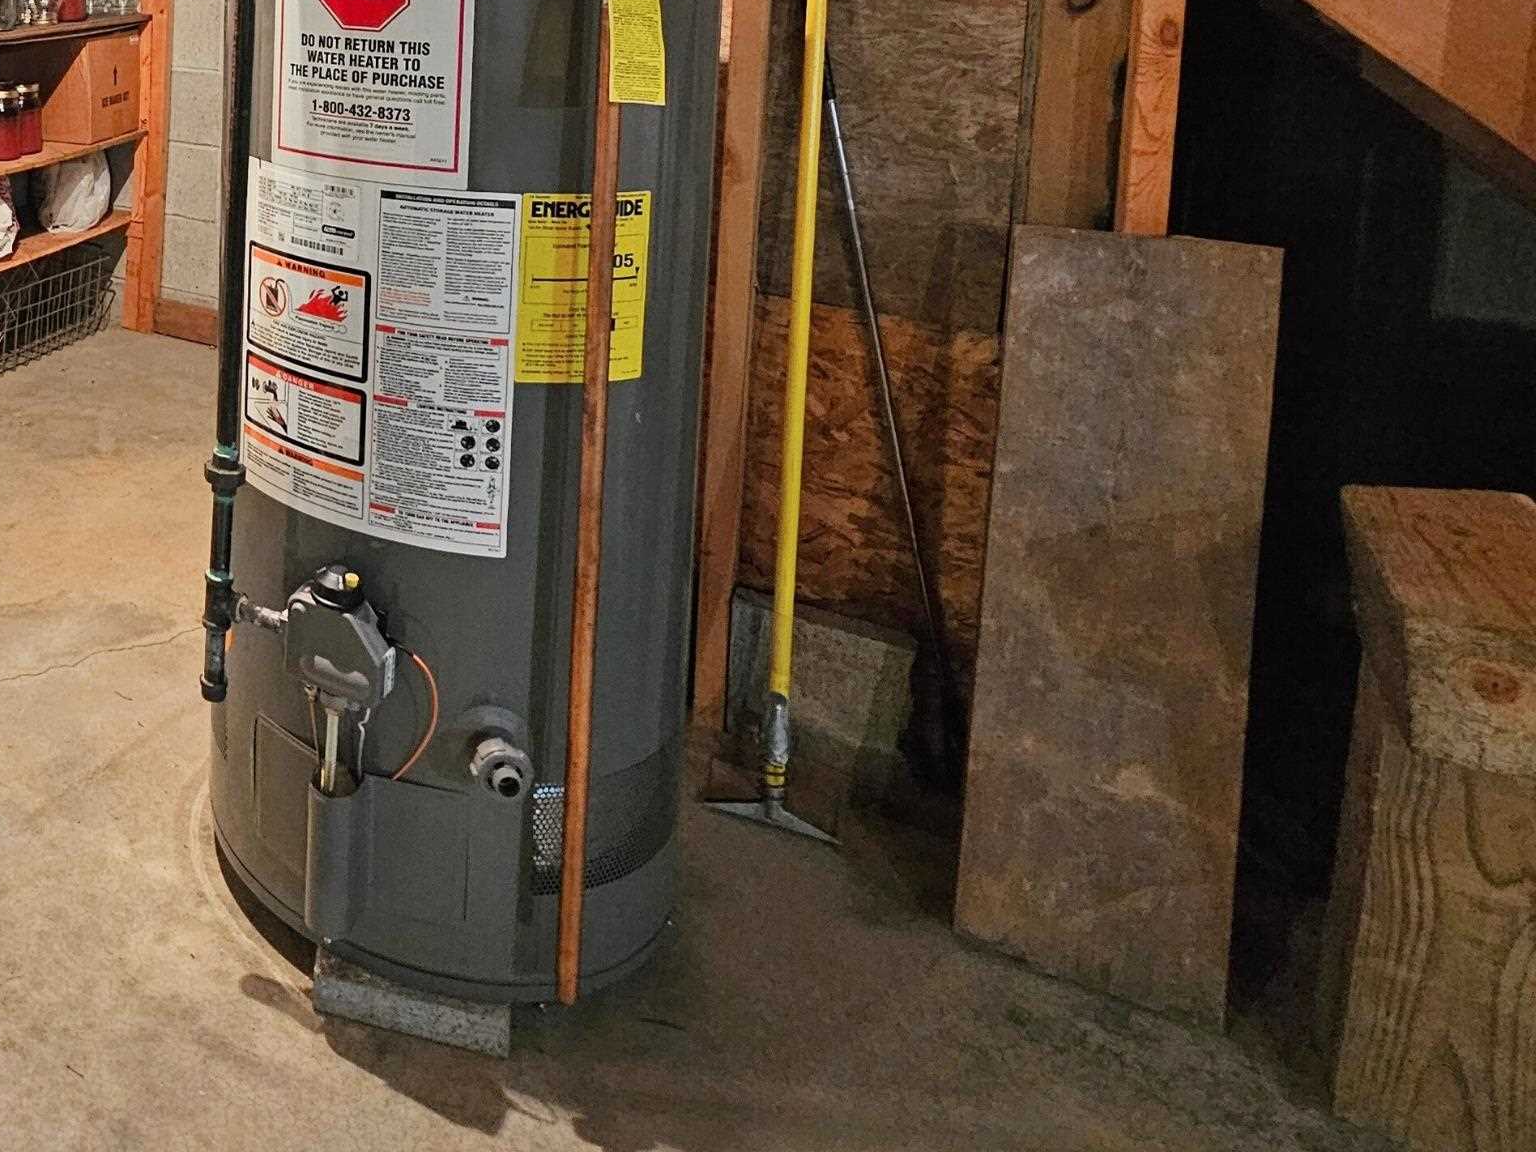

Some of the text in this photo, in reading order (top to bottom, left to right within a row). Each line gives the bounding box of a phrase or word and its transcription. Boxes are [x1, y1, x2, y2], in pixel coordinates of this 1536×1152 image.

[301, 33, 431, 56] DO NOT RETURN THIS
[307, 50, 421, 72] WATER HEATER TO
[290, 63, 445, 90] THE PLACE OF PURCHASE
[312, 99, 411, 122] 1-800-432-8373
[531, 199, 643, 219] ENERGIDE
[285, 259, 326, 278] WARNING
